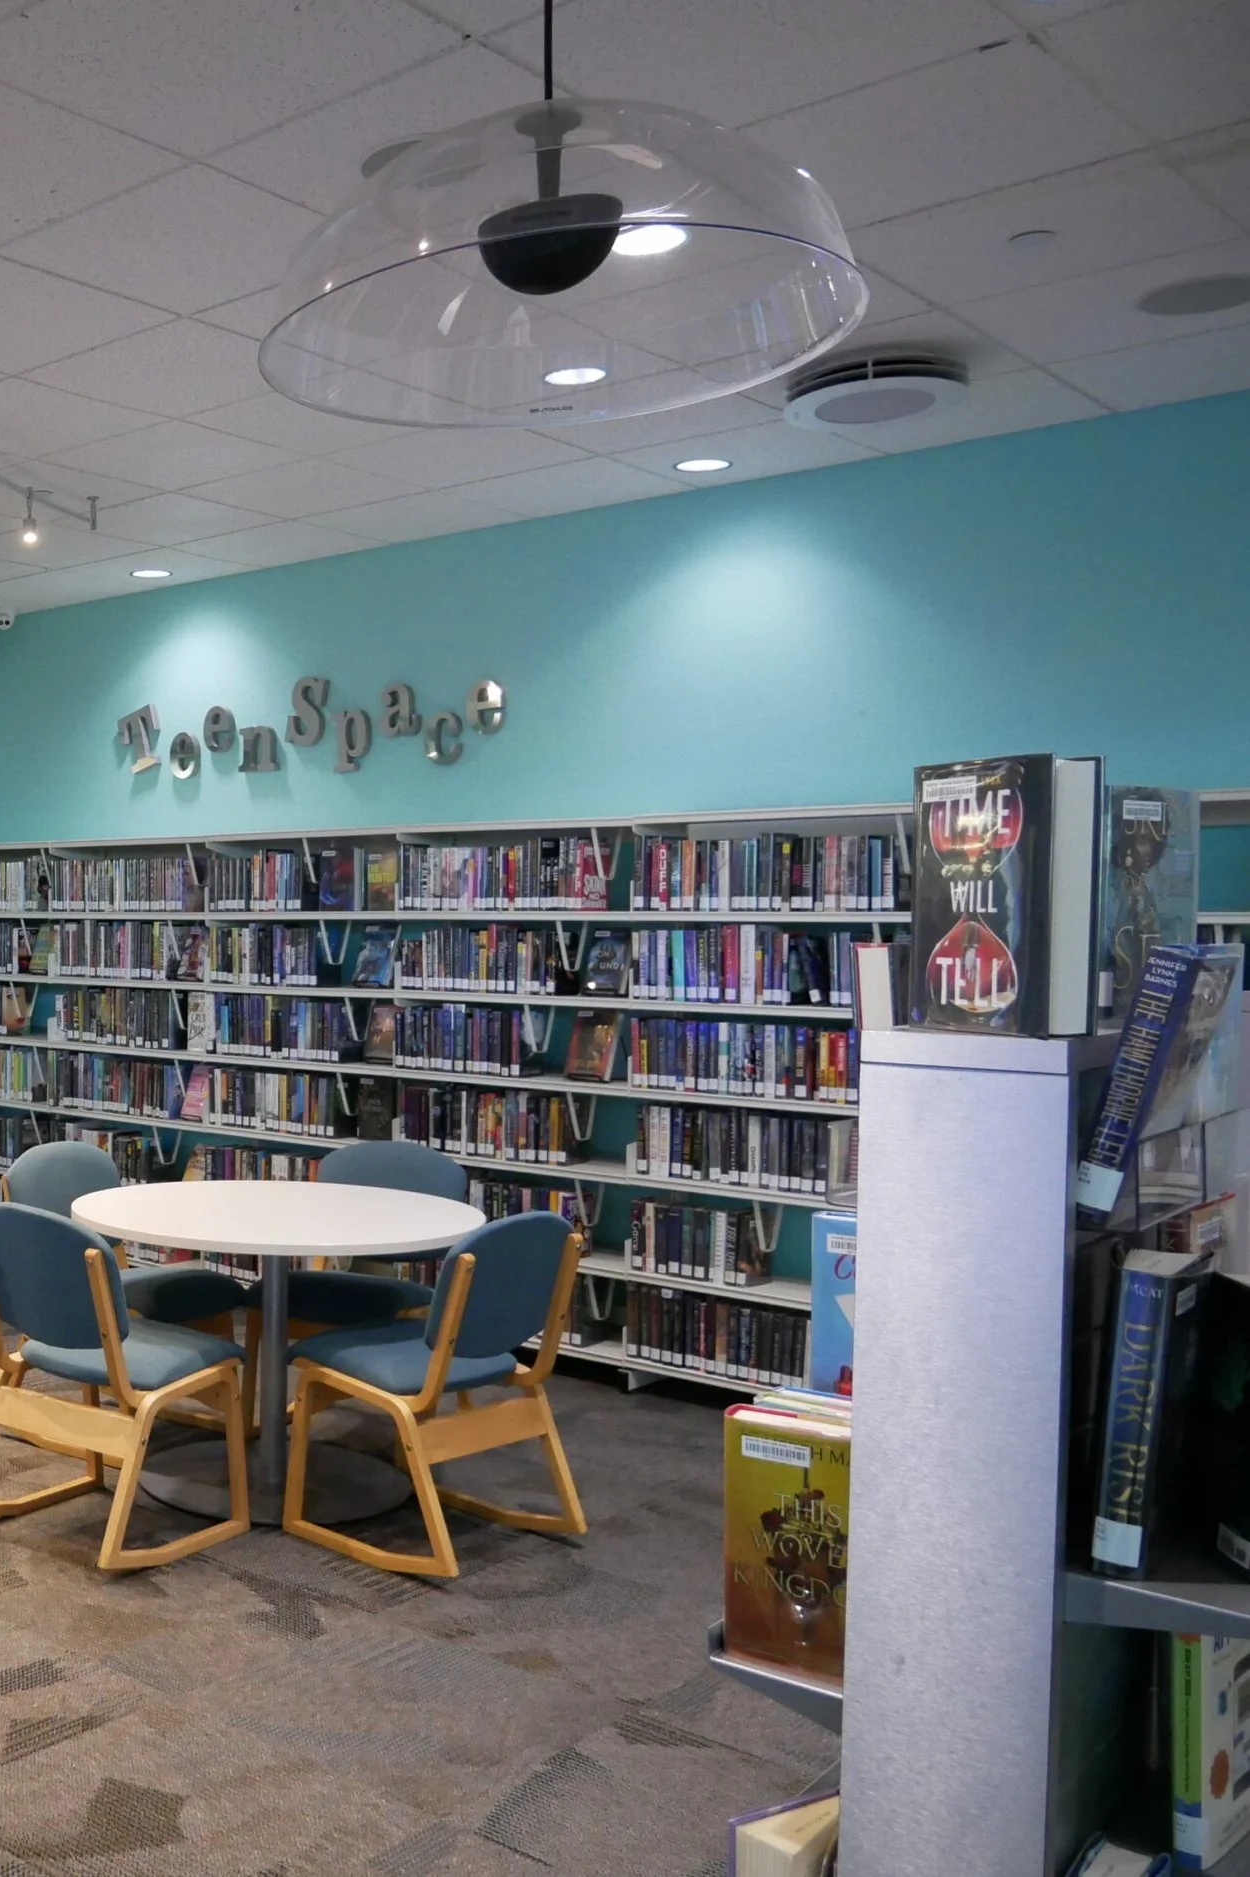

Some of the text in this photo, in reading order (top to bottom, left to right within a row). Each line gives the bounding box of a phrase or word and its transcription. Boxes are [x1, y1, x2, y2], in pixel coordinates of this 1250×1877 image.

[950, 880, 998, 914] WILL
[1144, 974, 1178, 989] BARNES
[1147, 956, 1188, 972] JENNIFER
[1152, 966, 1176, 978] LYNN
[936, 957, 1005, 1008] TELL
[1133, 988, 1174, 1024] THE
[1100, 1024, 1161, 1127] HAWTHORNE
[1126, 1283, 1162, 1299] ACAT
[1116, 1321, 1156, 1432] DARK
[774, 1492, 841, 1528] THIS
[750, 1526, 843, 1569] WOVE
[734, 1566, 846, 1610] KINGDO
